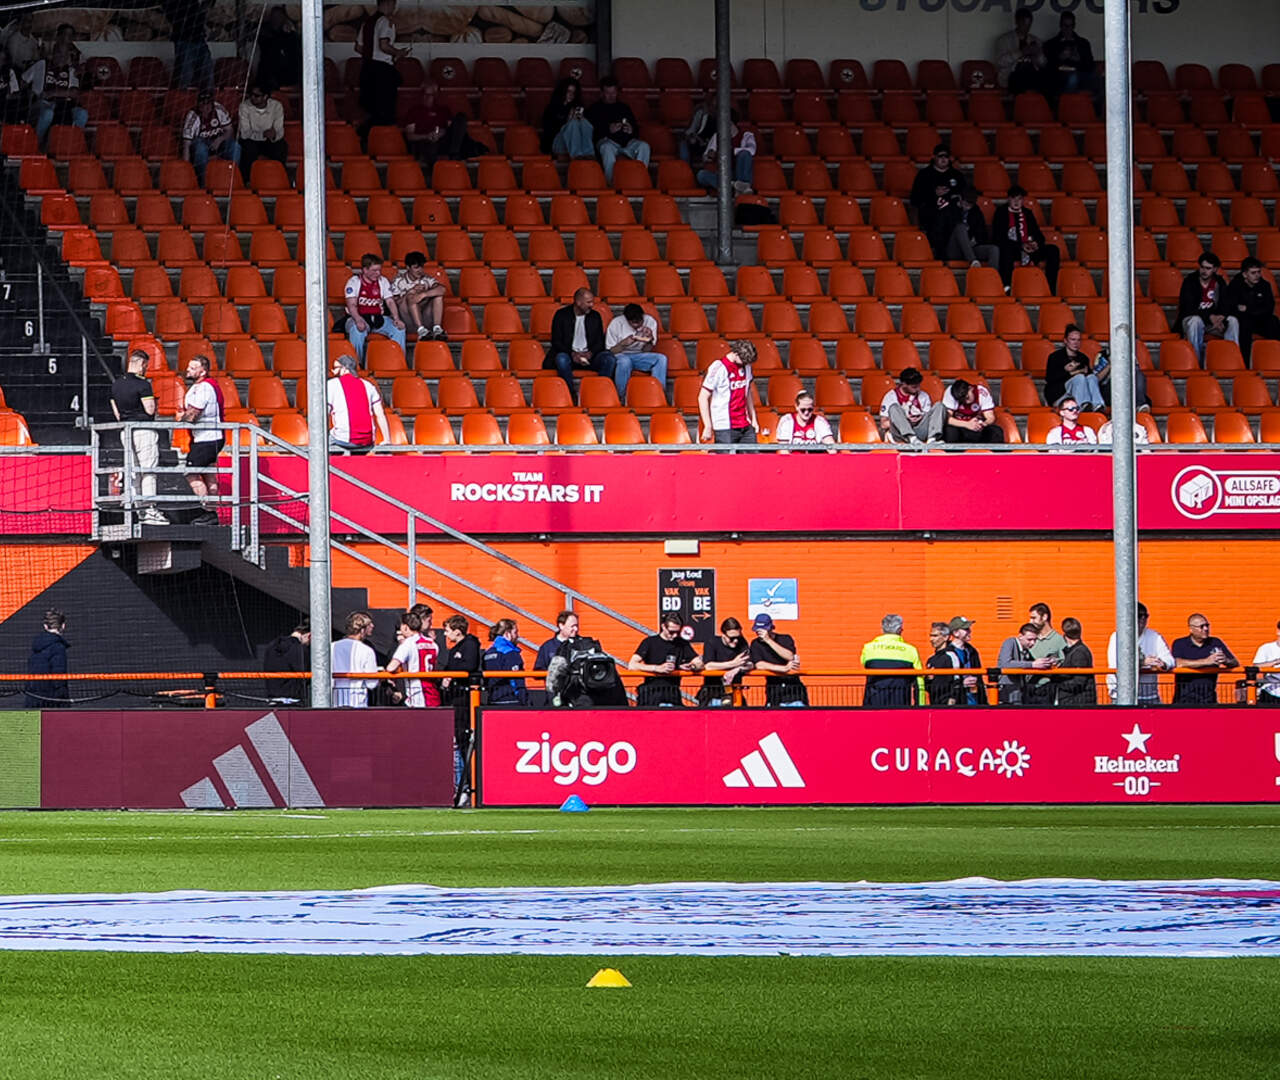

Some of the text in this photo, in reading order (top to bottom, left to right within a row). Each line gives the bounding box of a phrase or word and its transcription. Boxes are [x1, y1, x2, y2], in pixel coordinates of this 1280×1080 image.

[2, 284, 11, 300] 7
[24, 321, 34, 337] 6
[48, 358, 57, 374] 5
[70, 395, 80, 411] 4
[512, 472, 543, 482] TEAM
[451, 483, 604, 502] ROCKSTARS IT
[1231, 480, 1274, 491] ALLSAFE
[1224, 495, 1245, 506] MINI
[662, 597, 711, 610] BD BE
[515, 732, 637, 786] ziggo
[1094, 755, 1180, 773] Heineken
